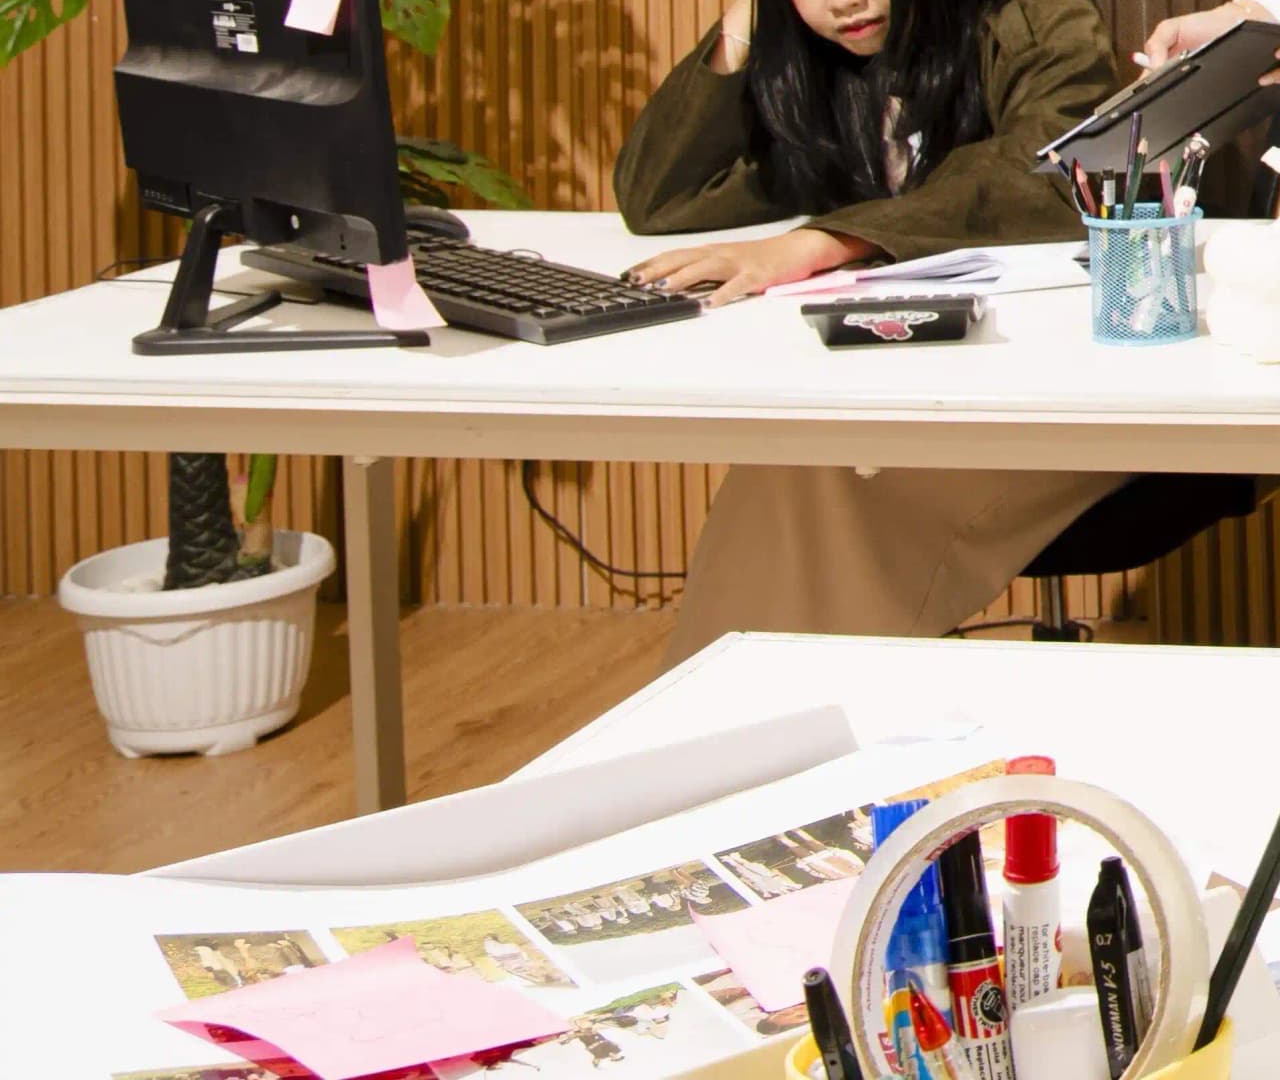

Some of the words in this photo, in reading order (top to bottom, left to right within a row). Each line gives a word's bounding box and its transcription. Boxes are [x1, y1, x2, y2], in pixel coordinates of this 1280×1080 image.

[1016, 925, 1025, 980] marqueur
[1031, 926, 1040, 963] replace
[1032, 967, 1040, 985] cap
[1100, 960, 1118, 989] V-5
[1107, 992, 1126, 1060] SNOWMAN
